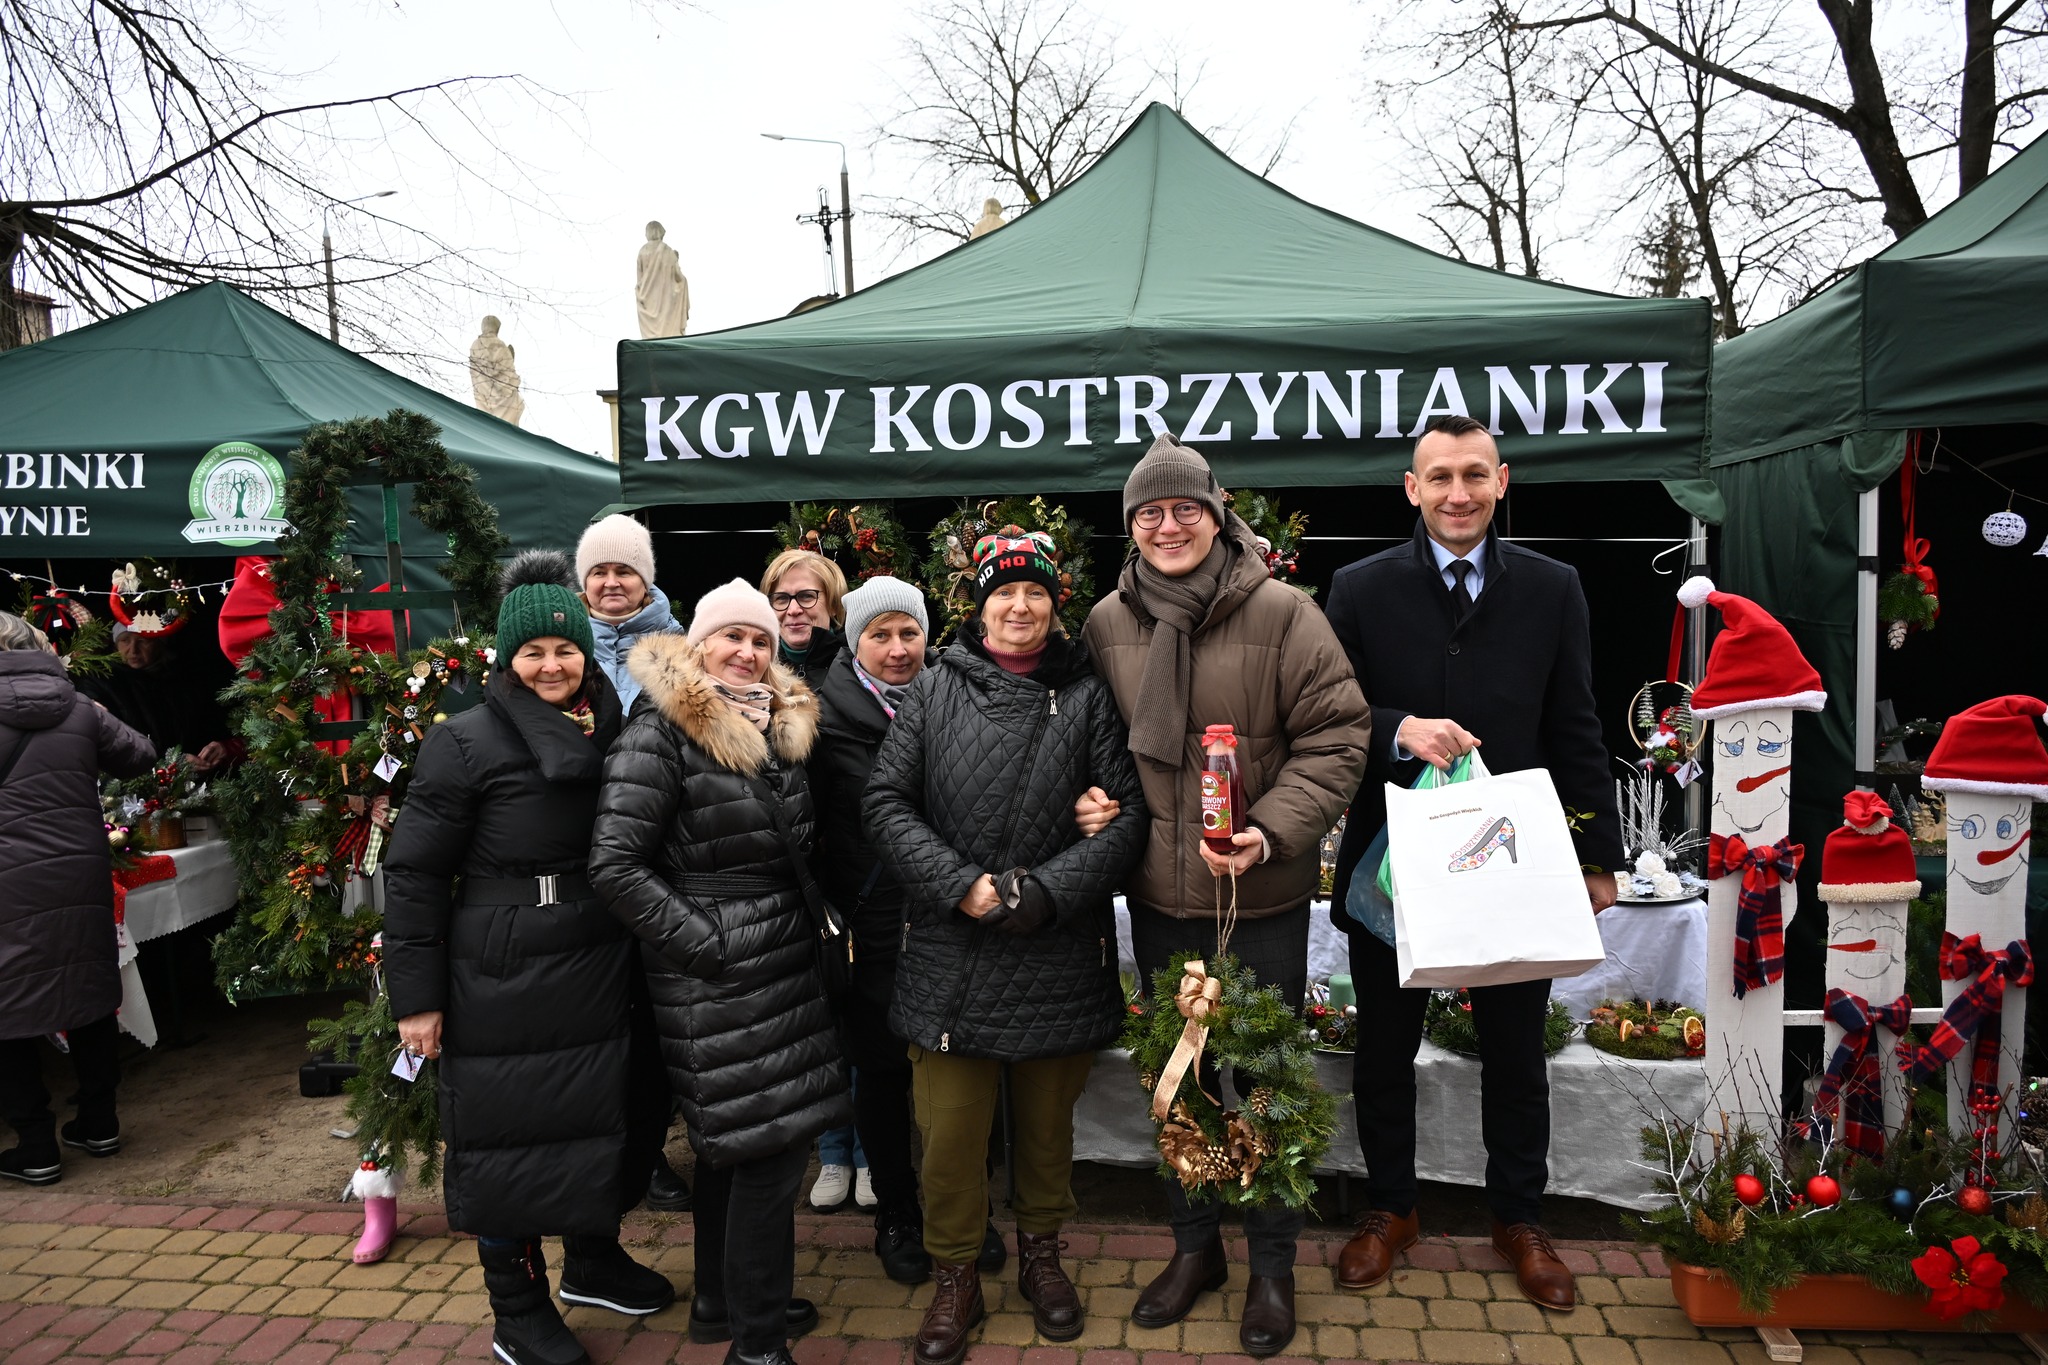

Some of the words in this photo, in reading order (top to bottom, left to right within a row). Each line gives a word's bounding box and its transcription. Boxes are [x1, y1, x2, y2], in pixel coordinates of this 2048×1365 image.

[641, 388, 845, 462] KGW
[869, 361, 1669, 452] KOSTRZYNIANKI
[0, 453, 146, 489] BINKI
[221, 446, 259, 457] WIEJSKICH
[261, 454, 269, 462] W
[978, 565, 995, 588] HO
[999, 555, 1027, 571] HO
[1034, 557, 1054, 577] HO
[1450, 816, 1496, 859] KOSTRZYNIANKI
